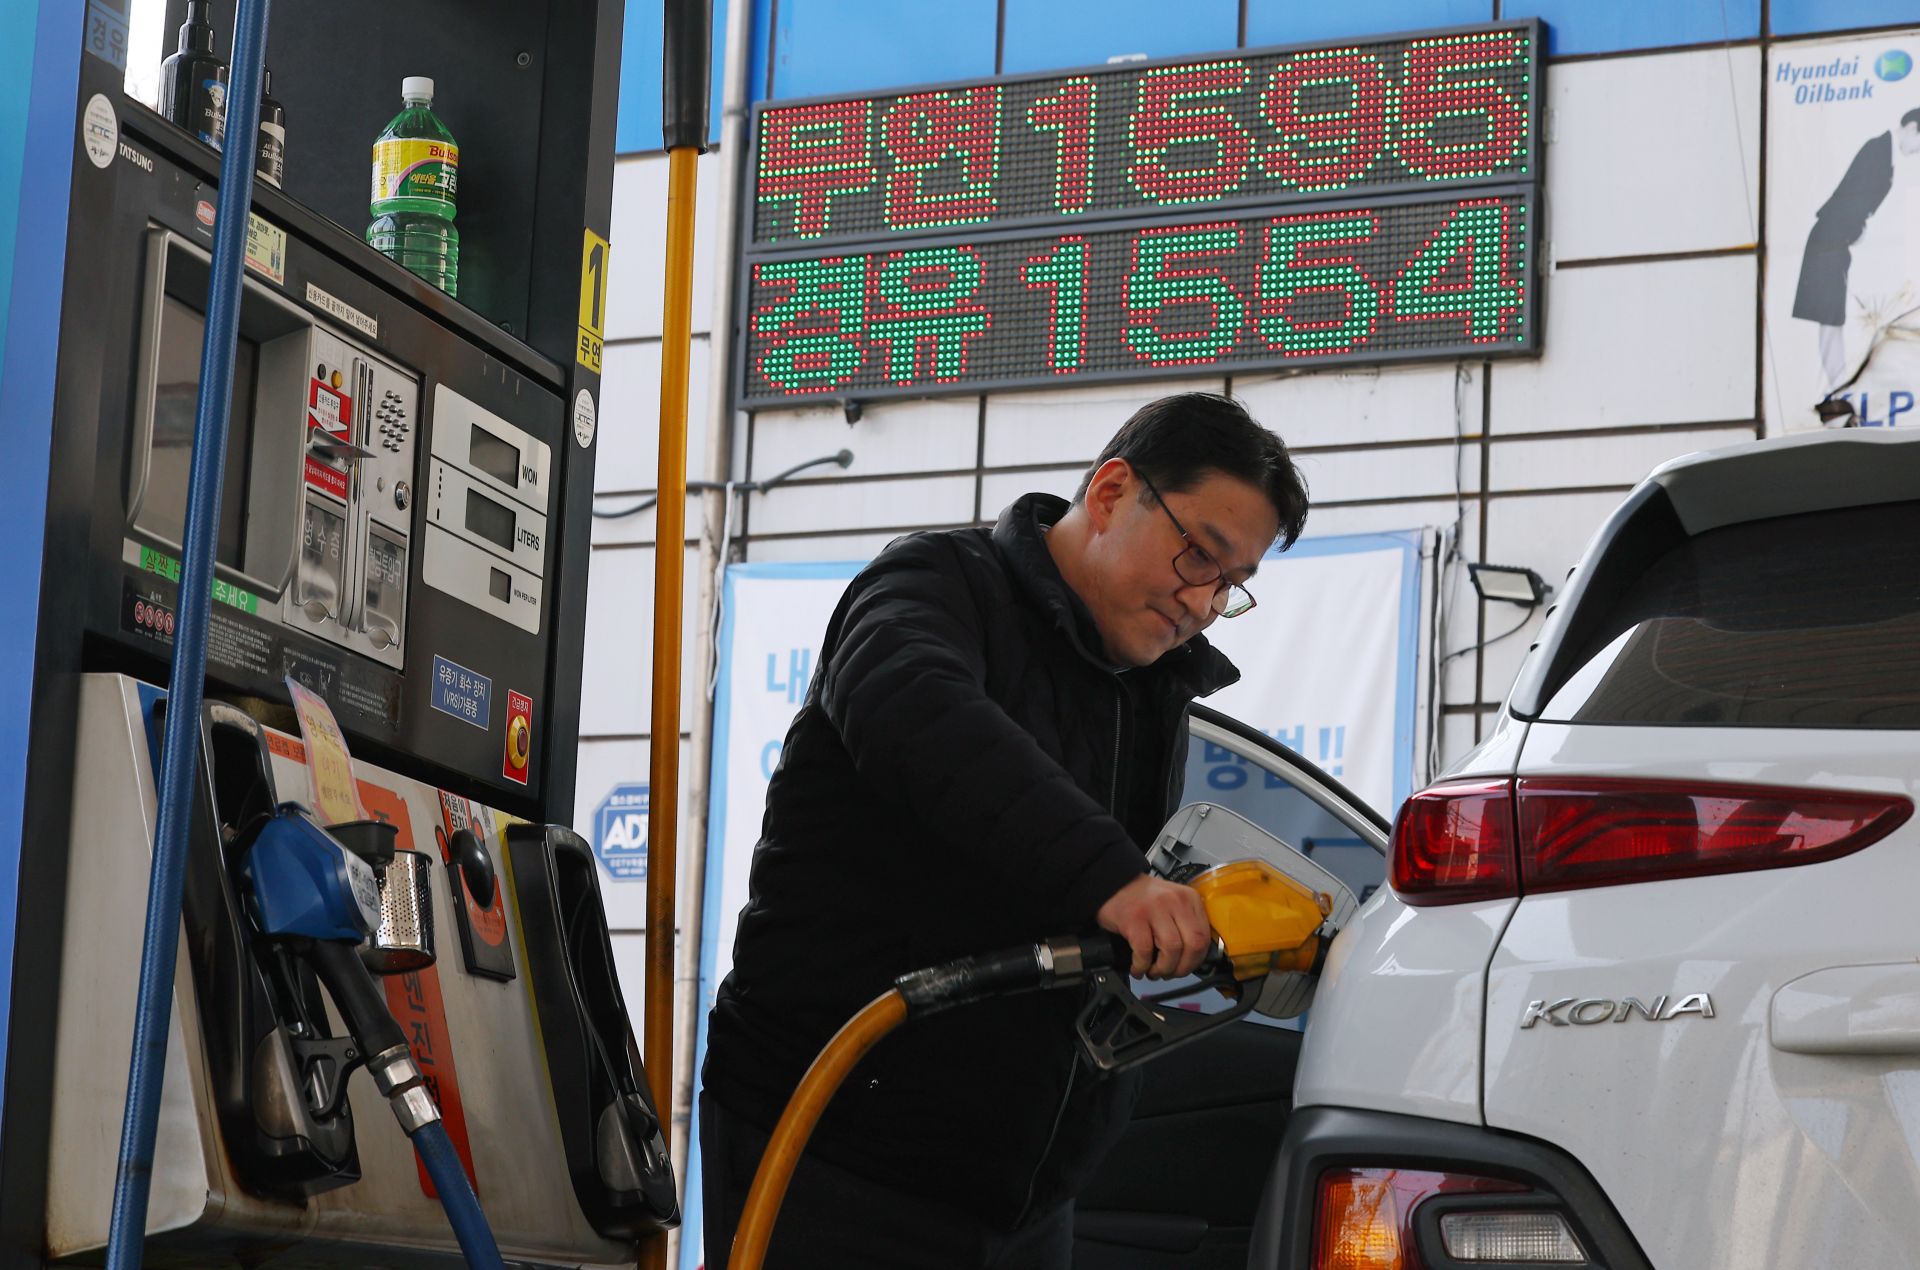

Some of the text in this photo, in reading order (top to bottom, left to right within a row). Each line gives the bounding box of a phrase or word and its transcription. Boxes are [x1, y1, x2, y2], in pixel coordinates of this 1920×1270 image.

[92, 16, 124, 63] 경유
[1775, 55, 1860, 85] Hyundai
[1794, 79, 1874, 105] Oilbank
[758, 32, 1528, 239] 무연 1595
[119, 141, 153, 173] TATSUNO
[588, 243, 604, 331] 1
[751, 198, 1523, 395] 경유 1554
[580, 334, 600, 369] 무연
[1824, 391, 1915, 427] LP
[522, 464, 538, 486] WON
[304, 519, 341, 560] 영수증
[517, 526, 540, 551] LITERS
[145, 550, 169, 578] 살짝
[215, 579, 248, 611] 주세요
[439, 664, 486, 701] 유증기 회수 장치
[443, 687, 478, 718] (VRS)가동중
[1519, 992, 1717, 1030] KONA
